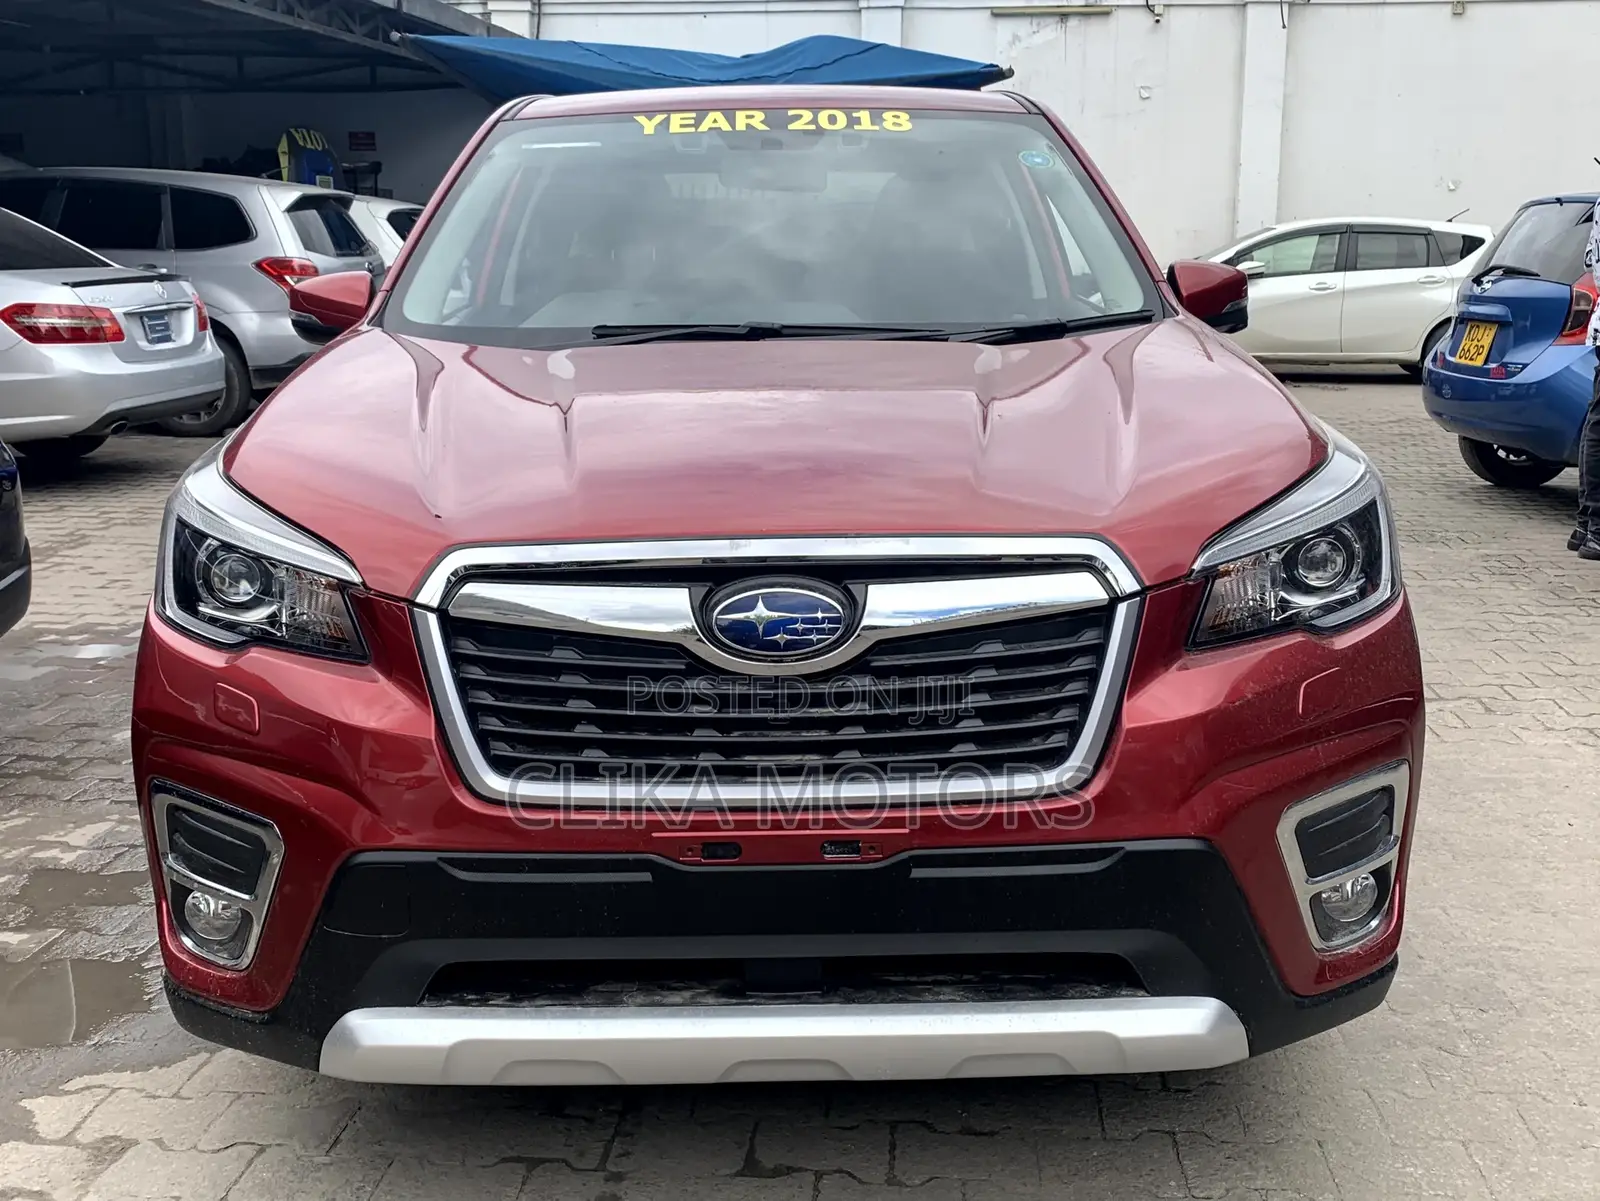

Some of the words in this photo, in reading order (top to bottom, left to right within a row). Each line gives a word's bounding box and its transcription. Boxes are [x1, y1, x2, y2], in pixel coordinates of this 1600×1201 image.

[632, 110, 770, 135] YEAR
[787, 109, 913, 132] 2018
[1459, 343, 1485, 362] 662P
